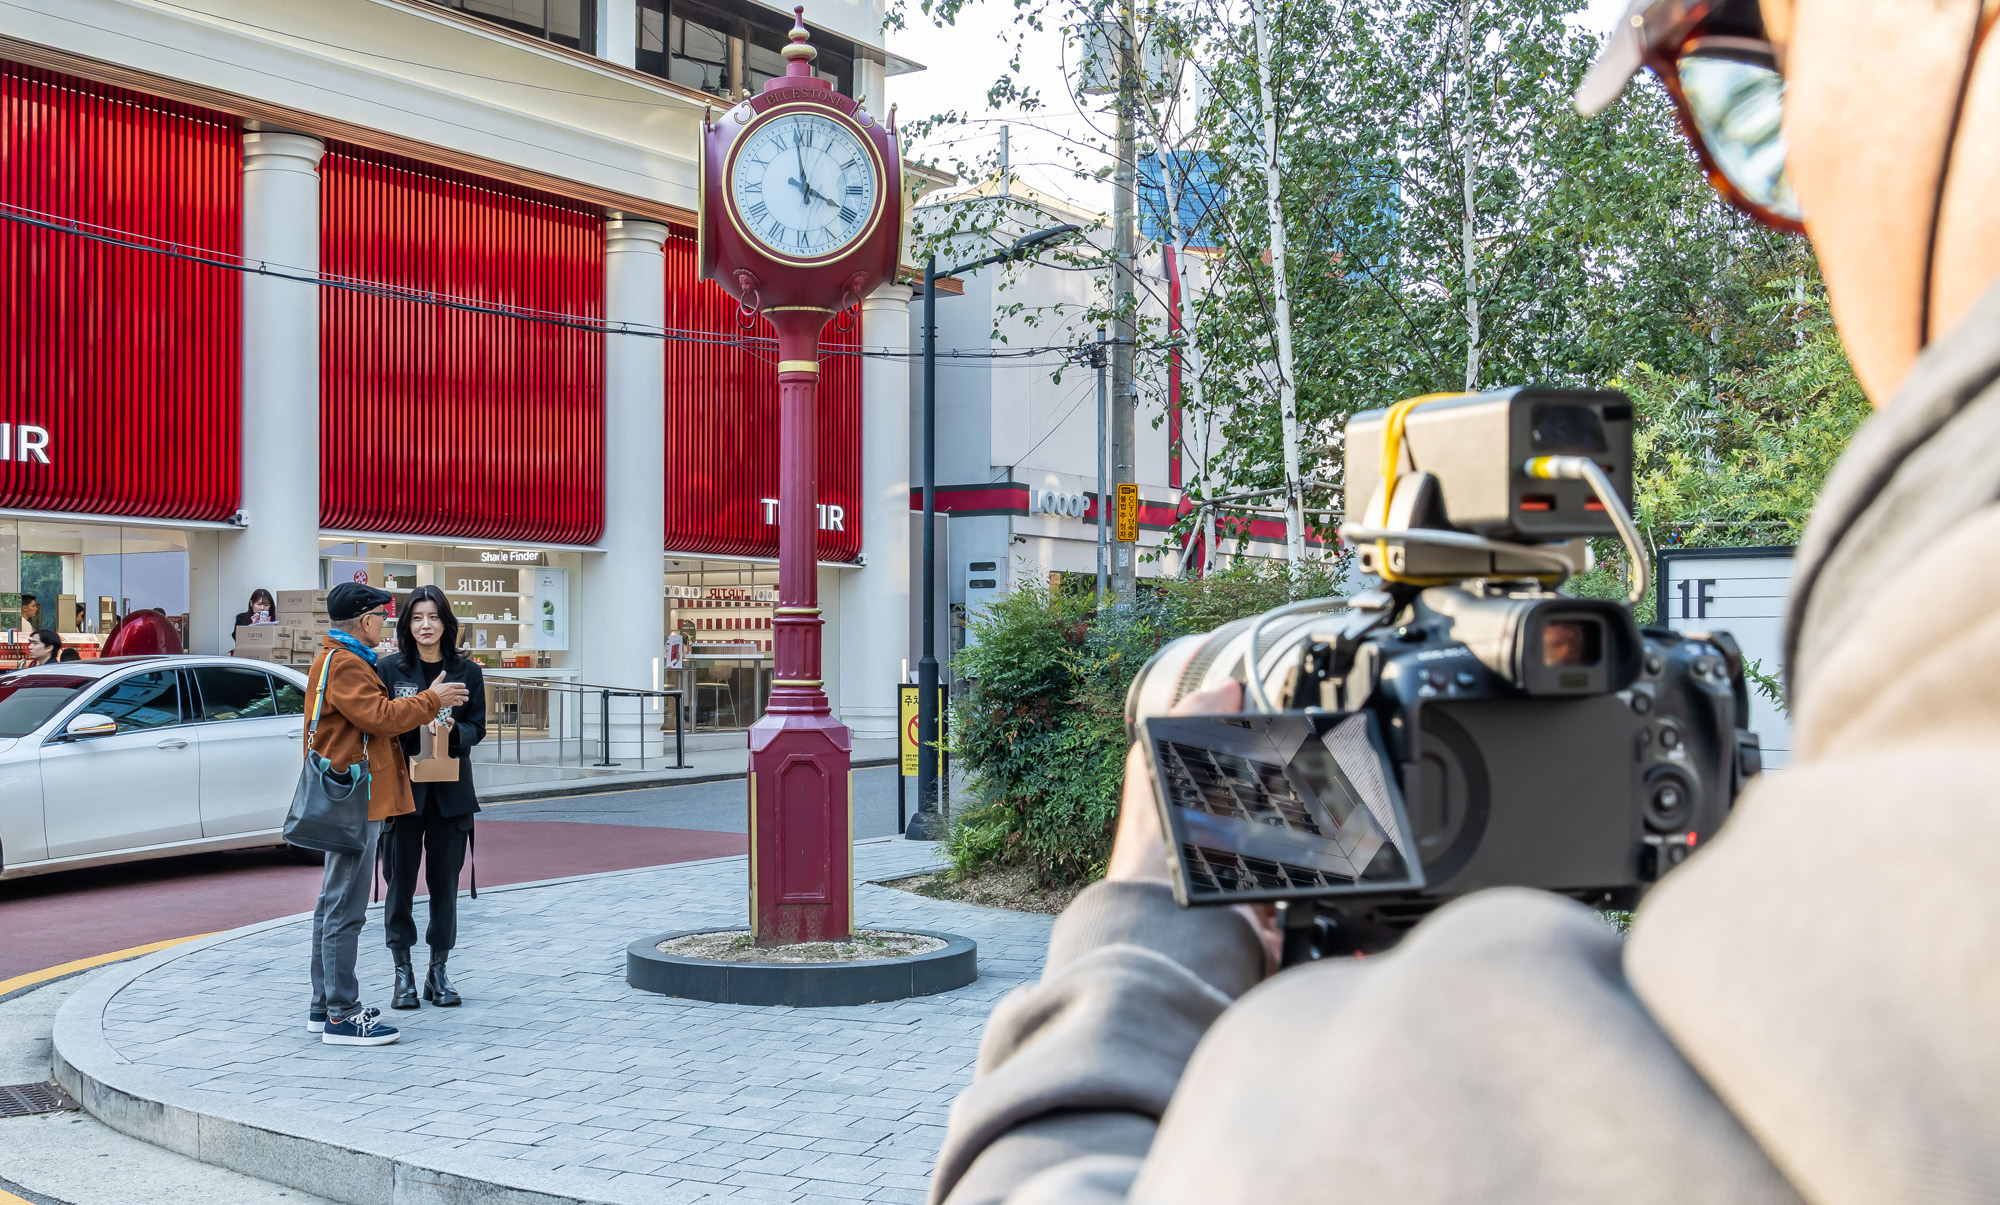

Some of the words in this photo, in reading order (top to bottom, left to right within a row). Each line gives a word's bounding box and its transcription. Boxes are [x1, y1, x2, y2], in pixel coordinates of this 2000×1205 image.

[765, 88, 845, 109] BLUESTONE
[0, 422, 50, 464] IR
[760, 498, 845, 531] TIR
[1030, 489, 1091, 518] LOOOP
[481, 551, 508, 562] Shade
[510, 551, 538, 561] Finder
[1677, 578, 1716, 619] 1F
